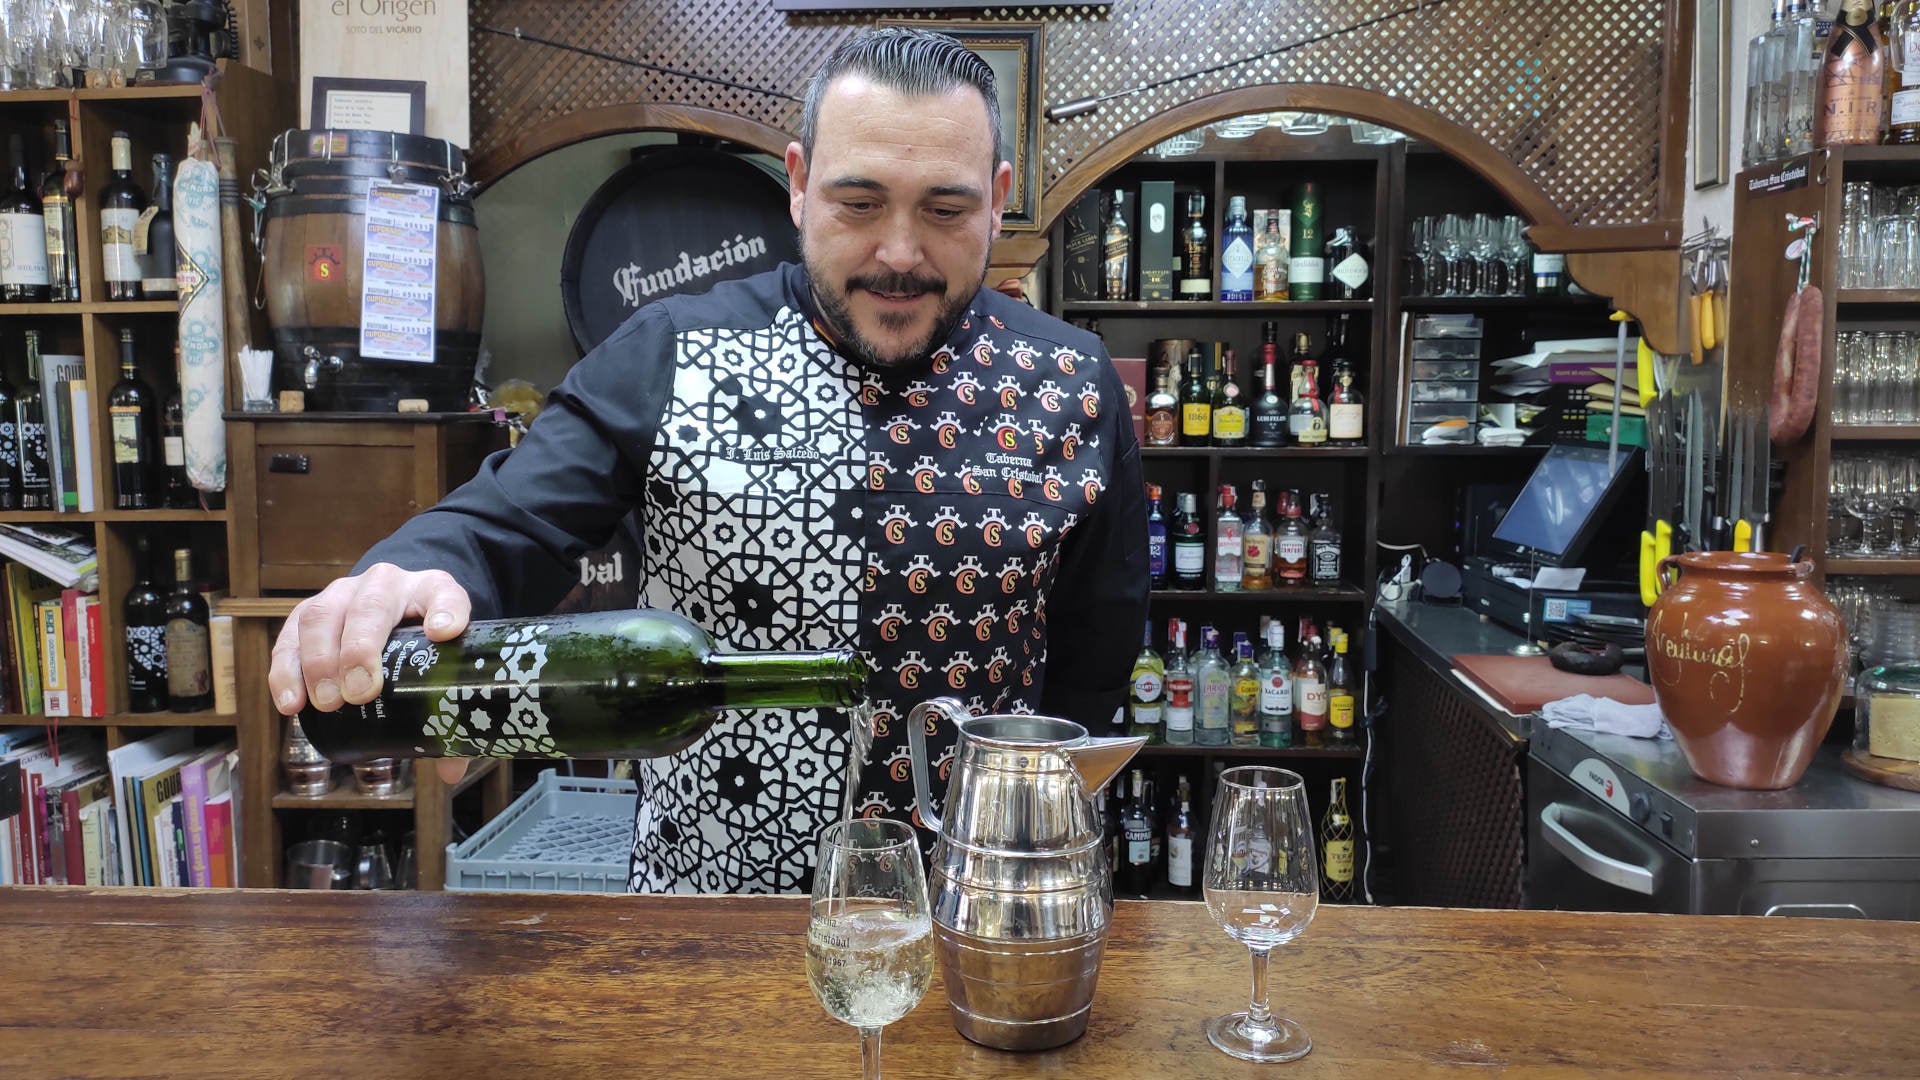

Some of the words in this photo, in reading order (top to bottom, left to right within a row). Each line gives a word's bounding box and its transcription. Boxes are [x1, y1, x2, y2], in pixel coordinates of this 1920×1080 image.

[331, 0, 350, 16] el
[360, 0, 437, 22] Origen
[345, 26, 367, 34] SOTO
[369, 26, 384, 34] DEL
[386, 26, 422, 34] VICARIO
[1302, 228, 1314, 239] 12
[612, 233, 767, 307] Fundación
[743, 447, 771, 461] Luis
[773, 447, 820, 460] Salcedo
[985, 452, 1033, 467] Taberna
[972, 465, 997, 478] San
[391, 639, 419, 681] Taberna
